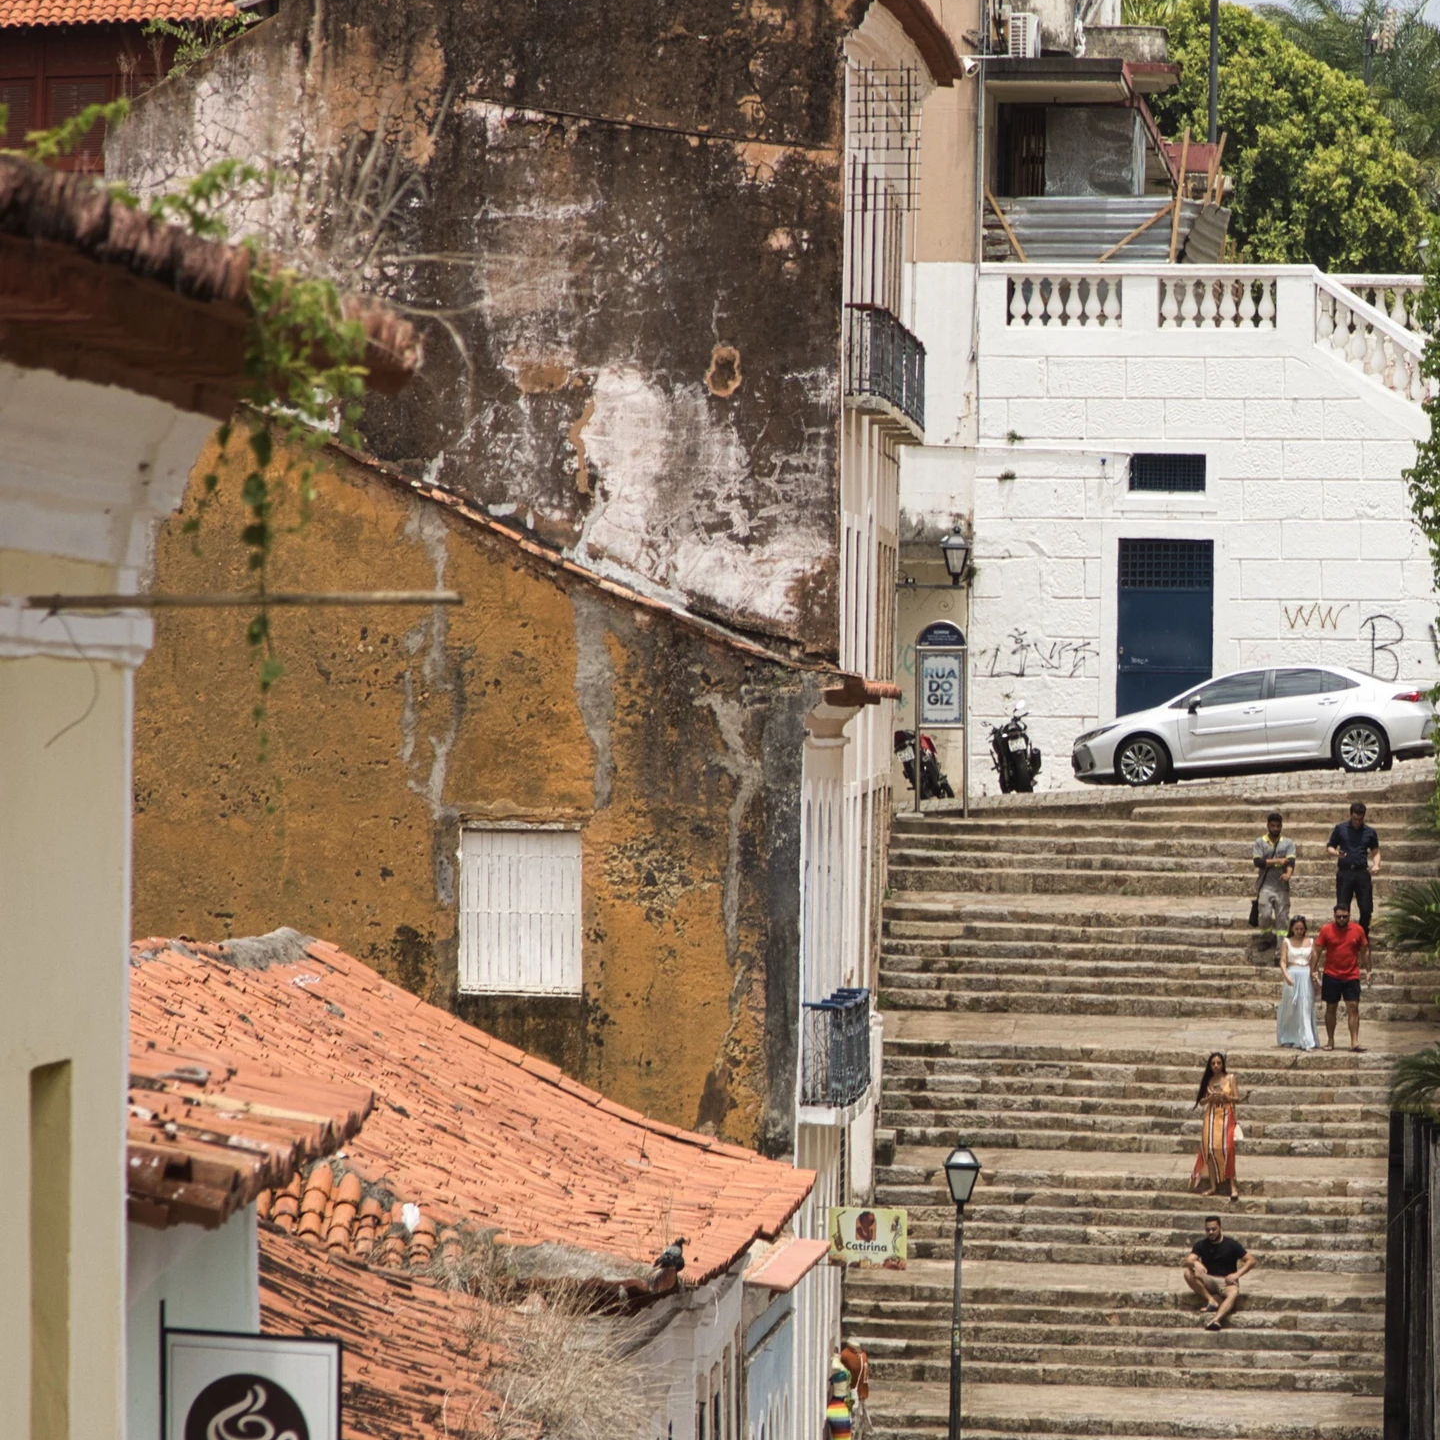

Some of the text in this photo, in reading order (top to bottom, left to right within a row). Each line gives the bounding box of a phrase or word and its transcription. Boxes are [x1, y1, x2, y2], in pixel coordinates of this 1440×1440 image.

[924, 666, 958, 679] RUA
[928, 680, 953, 693] DO
[927, 693, 954, 706] GIZ
[845, 1241, 888, 1252] Catirina
